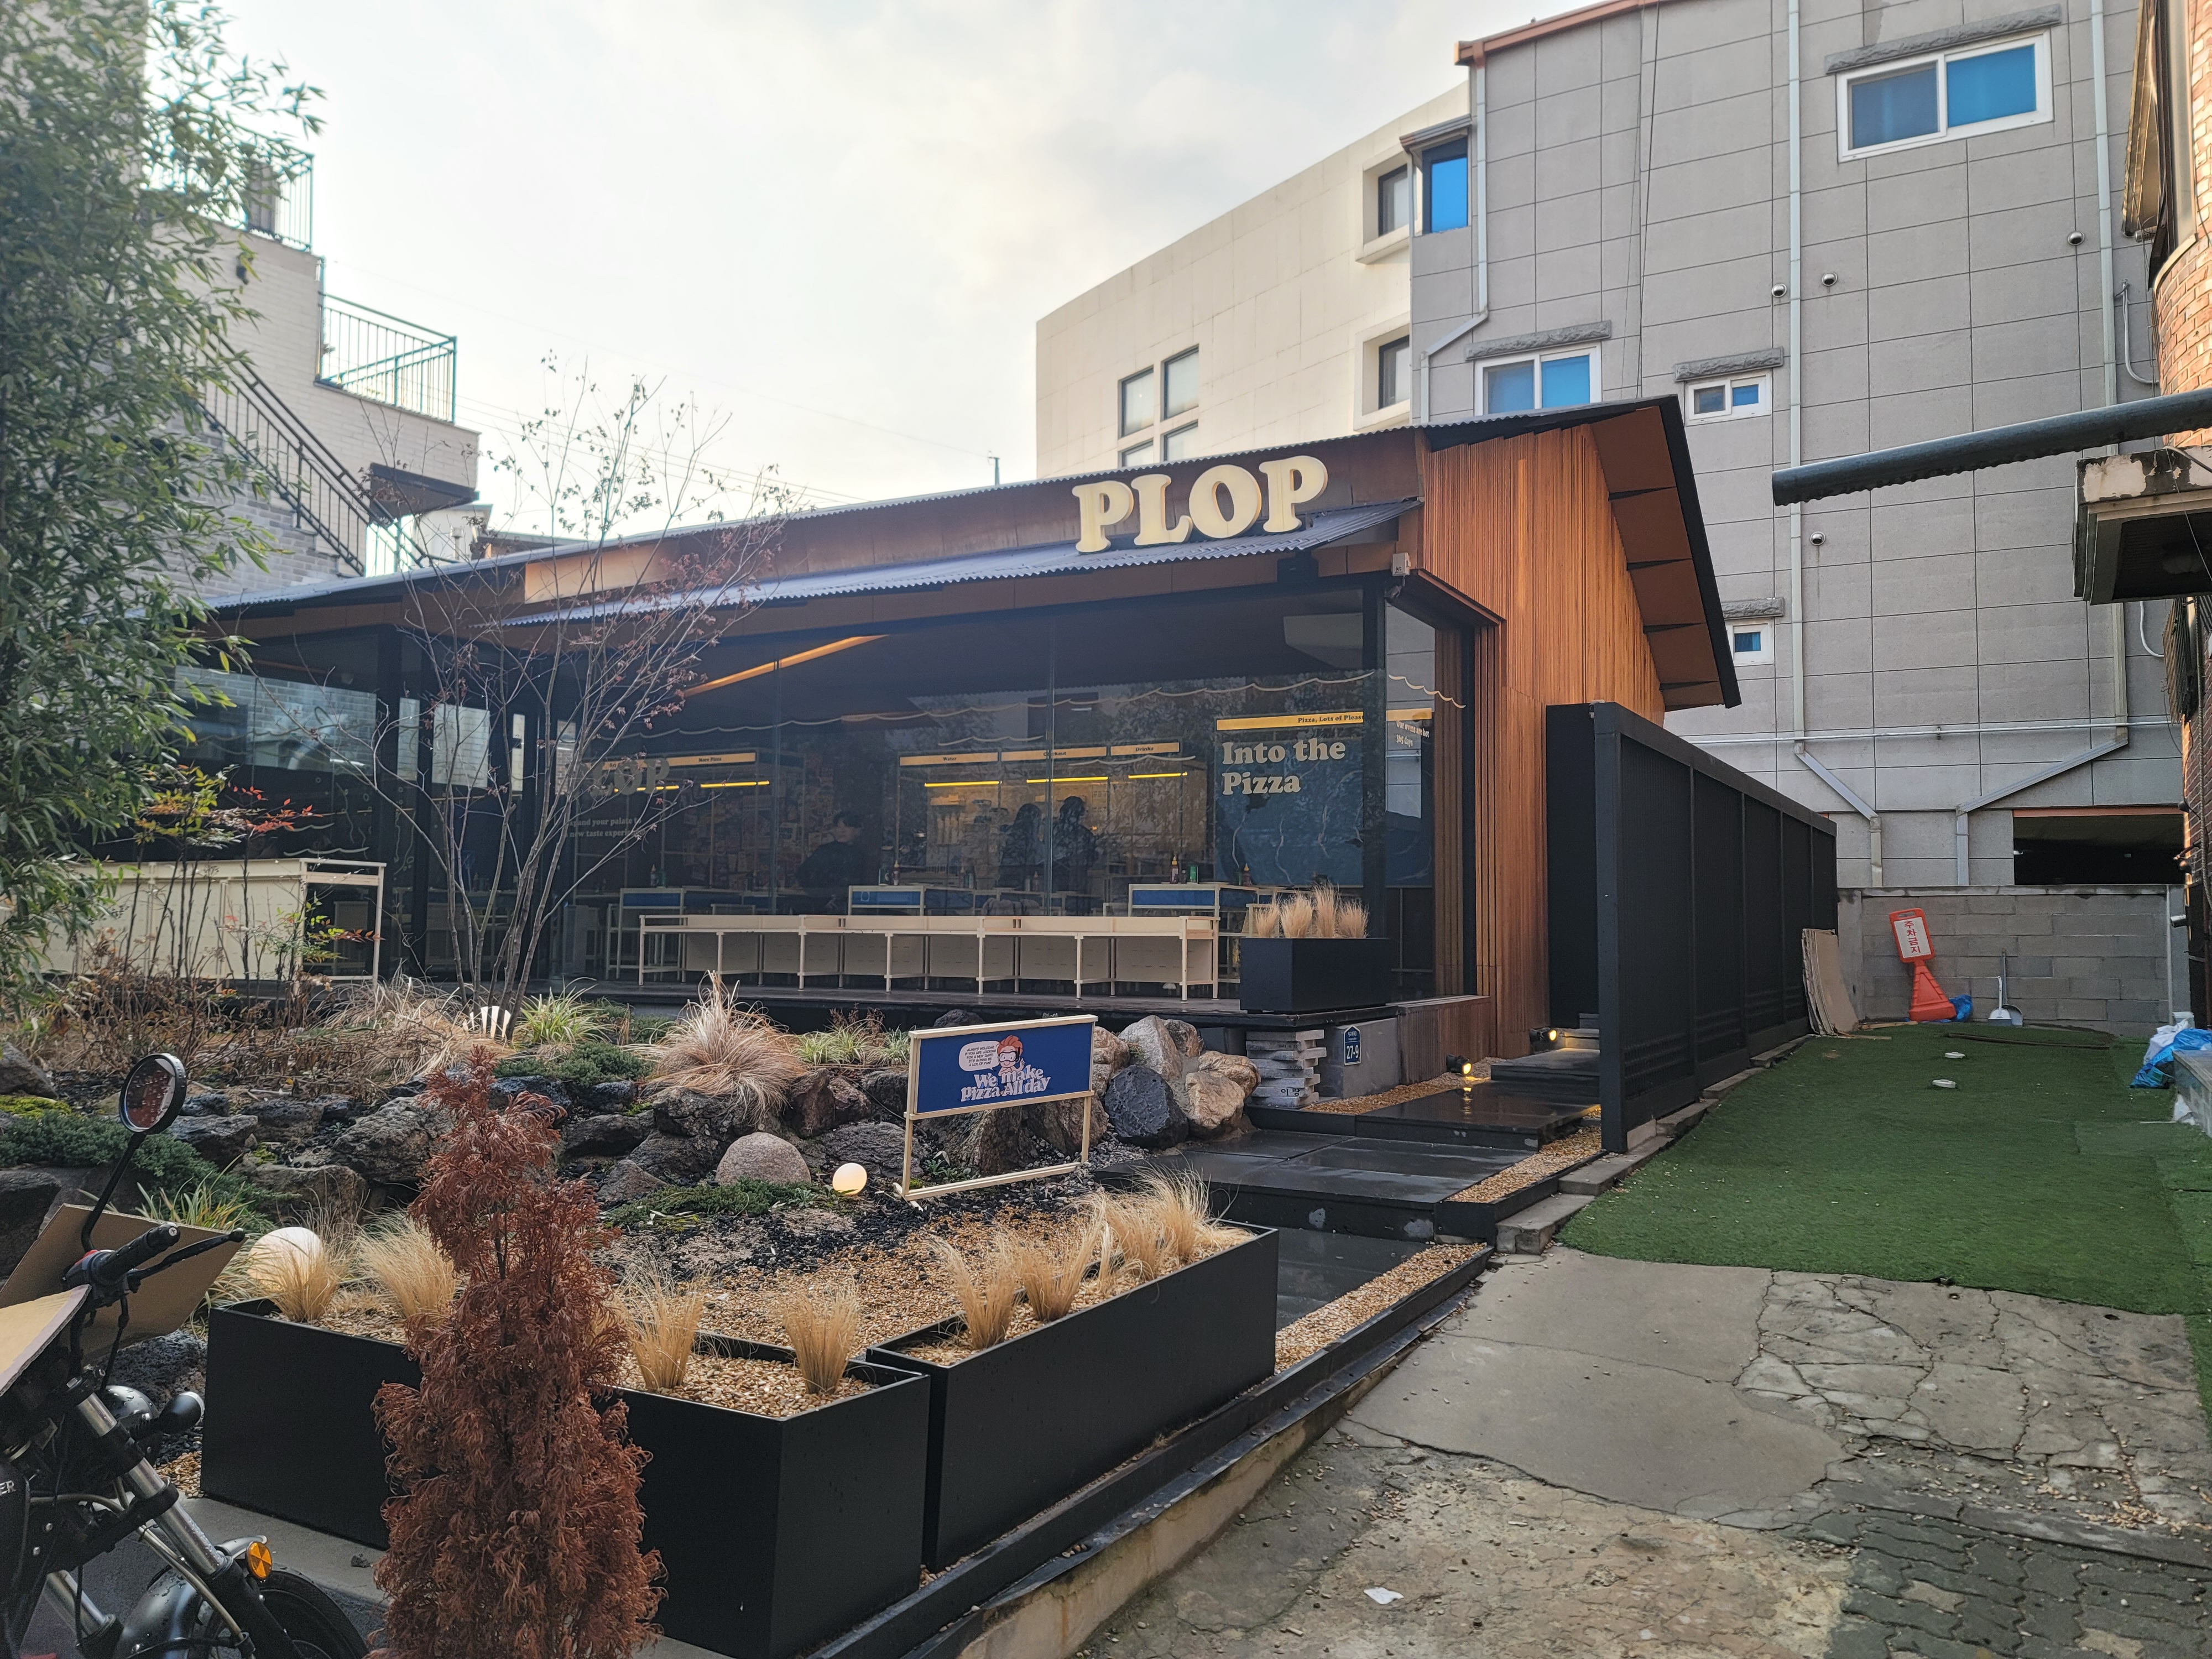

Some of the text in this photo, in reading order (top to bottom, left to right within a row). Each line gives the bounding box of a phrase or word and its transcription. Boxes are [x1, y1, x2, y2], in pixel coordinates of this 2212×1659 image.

[1072, 455, 1328, 552] PLOP
[1222, 737, 1346, 765] Into the
[1404, 736, 1413, 748] days
[1222, 771, 1301, 795] Pizza
[568, 818, 591, 827] xpand
[592, 819, 609, 827] your
[1904, 920, 1921, 953] 주차금지
[1346, 1044, 1359, 1060] 27-9
[974, 1064, 1044, 1088] We make
[1001, 1080, 1024, 1097] All
[1024, 1076, 1051, 1093] day
